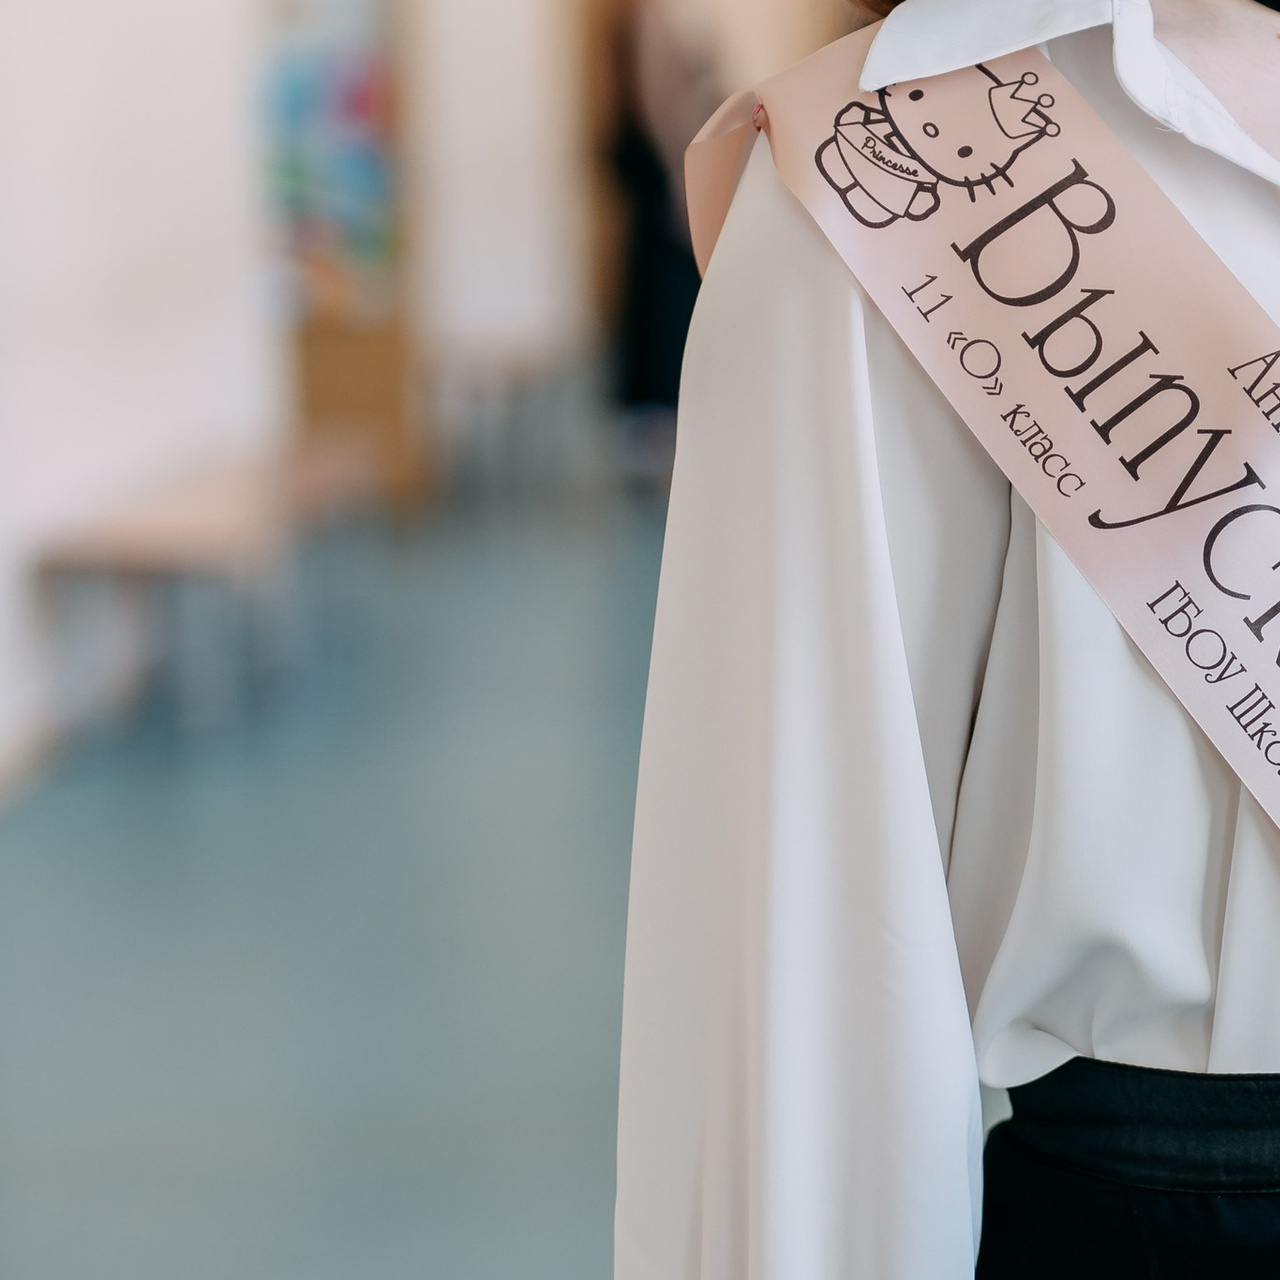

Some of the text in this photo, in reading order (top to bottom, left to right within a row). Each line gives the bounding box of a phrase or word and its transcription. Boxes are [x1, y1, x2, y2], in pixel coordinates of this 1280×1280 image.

[860, 135, 919, 177] Princesse
[900, 274, 1087, 499] 11 «О» класс
[1145, 579, 1248, 685] ГБОУ
